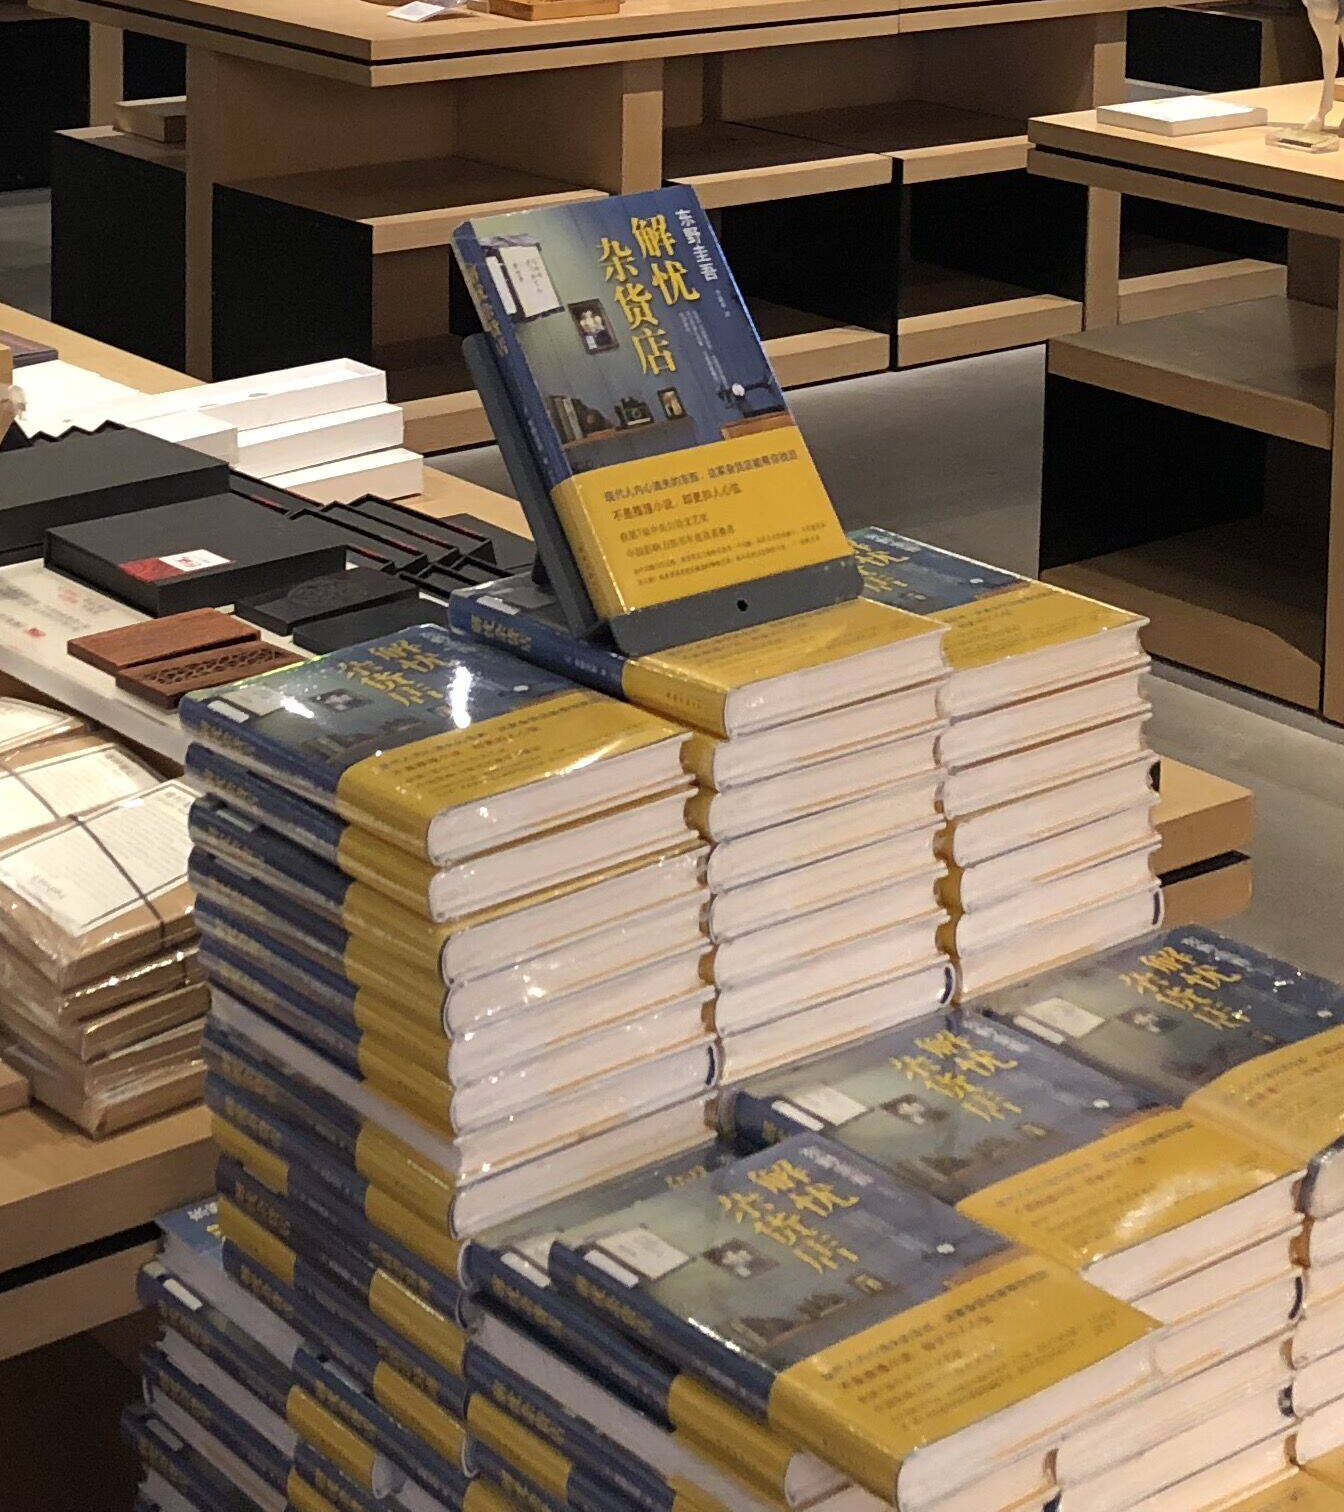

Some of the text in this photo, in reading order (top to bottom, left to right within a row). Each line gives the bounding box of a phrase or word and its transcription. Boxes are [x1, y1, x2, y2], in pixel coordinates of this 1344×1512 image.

[631, 214, 701, 306] 解忧
[675, 208, 719, 282] 东野圭吾
[595, 237, 678, 376] 杂货店
